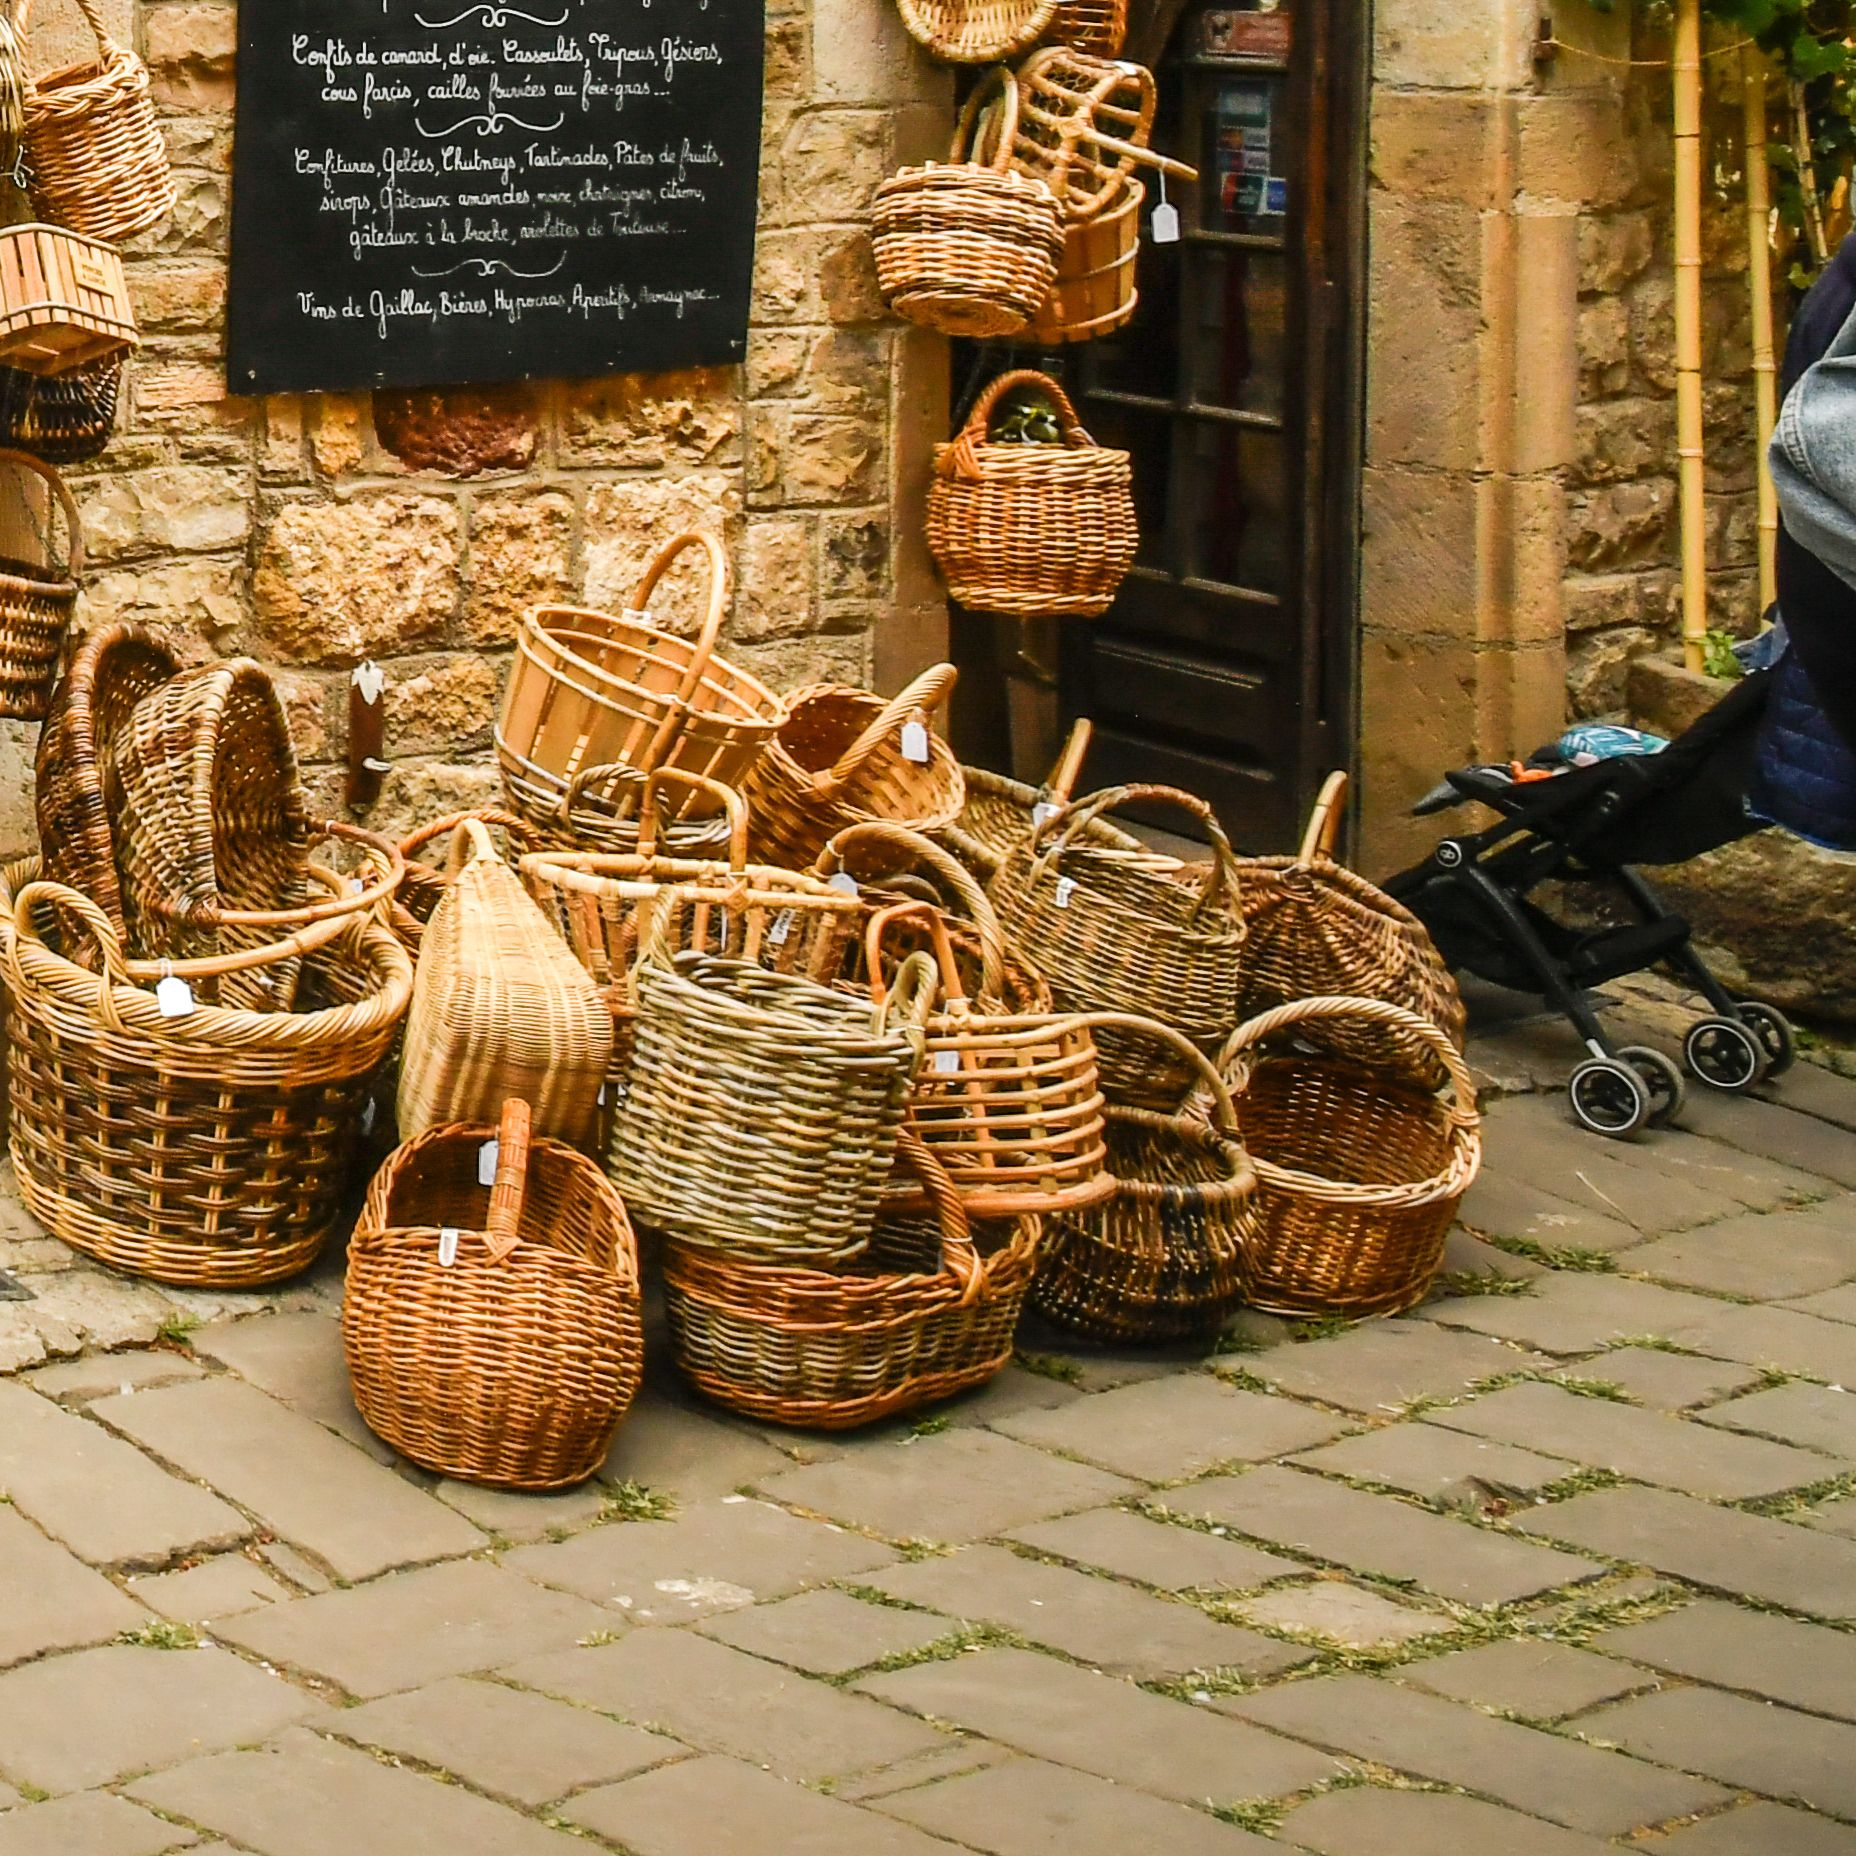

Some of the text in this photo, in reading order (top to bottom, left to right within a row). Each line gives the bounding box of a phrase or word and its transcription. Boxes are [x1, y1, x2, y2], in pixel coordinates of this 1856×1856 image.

[292, 32, 722, 84] Confits canard, Cassoulets, Tripous, Gésiers,
[321, 72, 576, 120] cous farcis, cailles au
[294, 137, 723, 190] Confitures, Gelées, Chutneys, Tartinades, Pâtes fruits,
[319, 183, 535, 234] sirops, Gâteaux amandes,
[349, 218, 457, 261] gâteaux à la
[297, 288, 572, 339] Vins de Gaillac, Bières, Hypocras,
